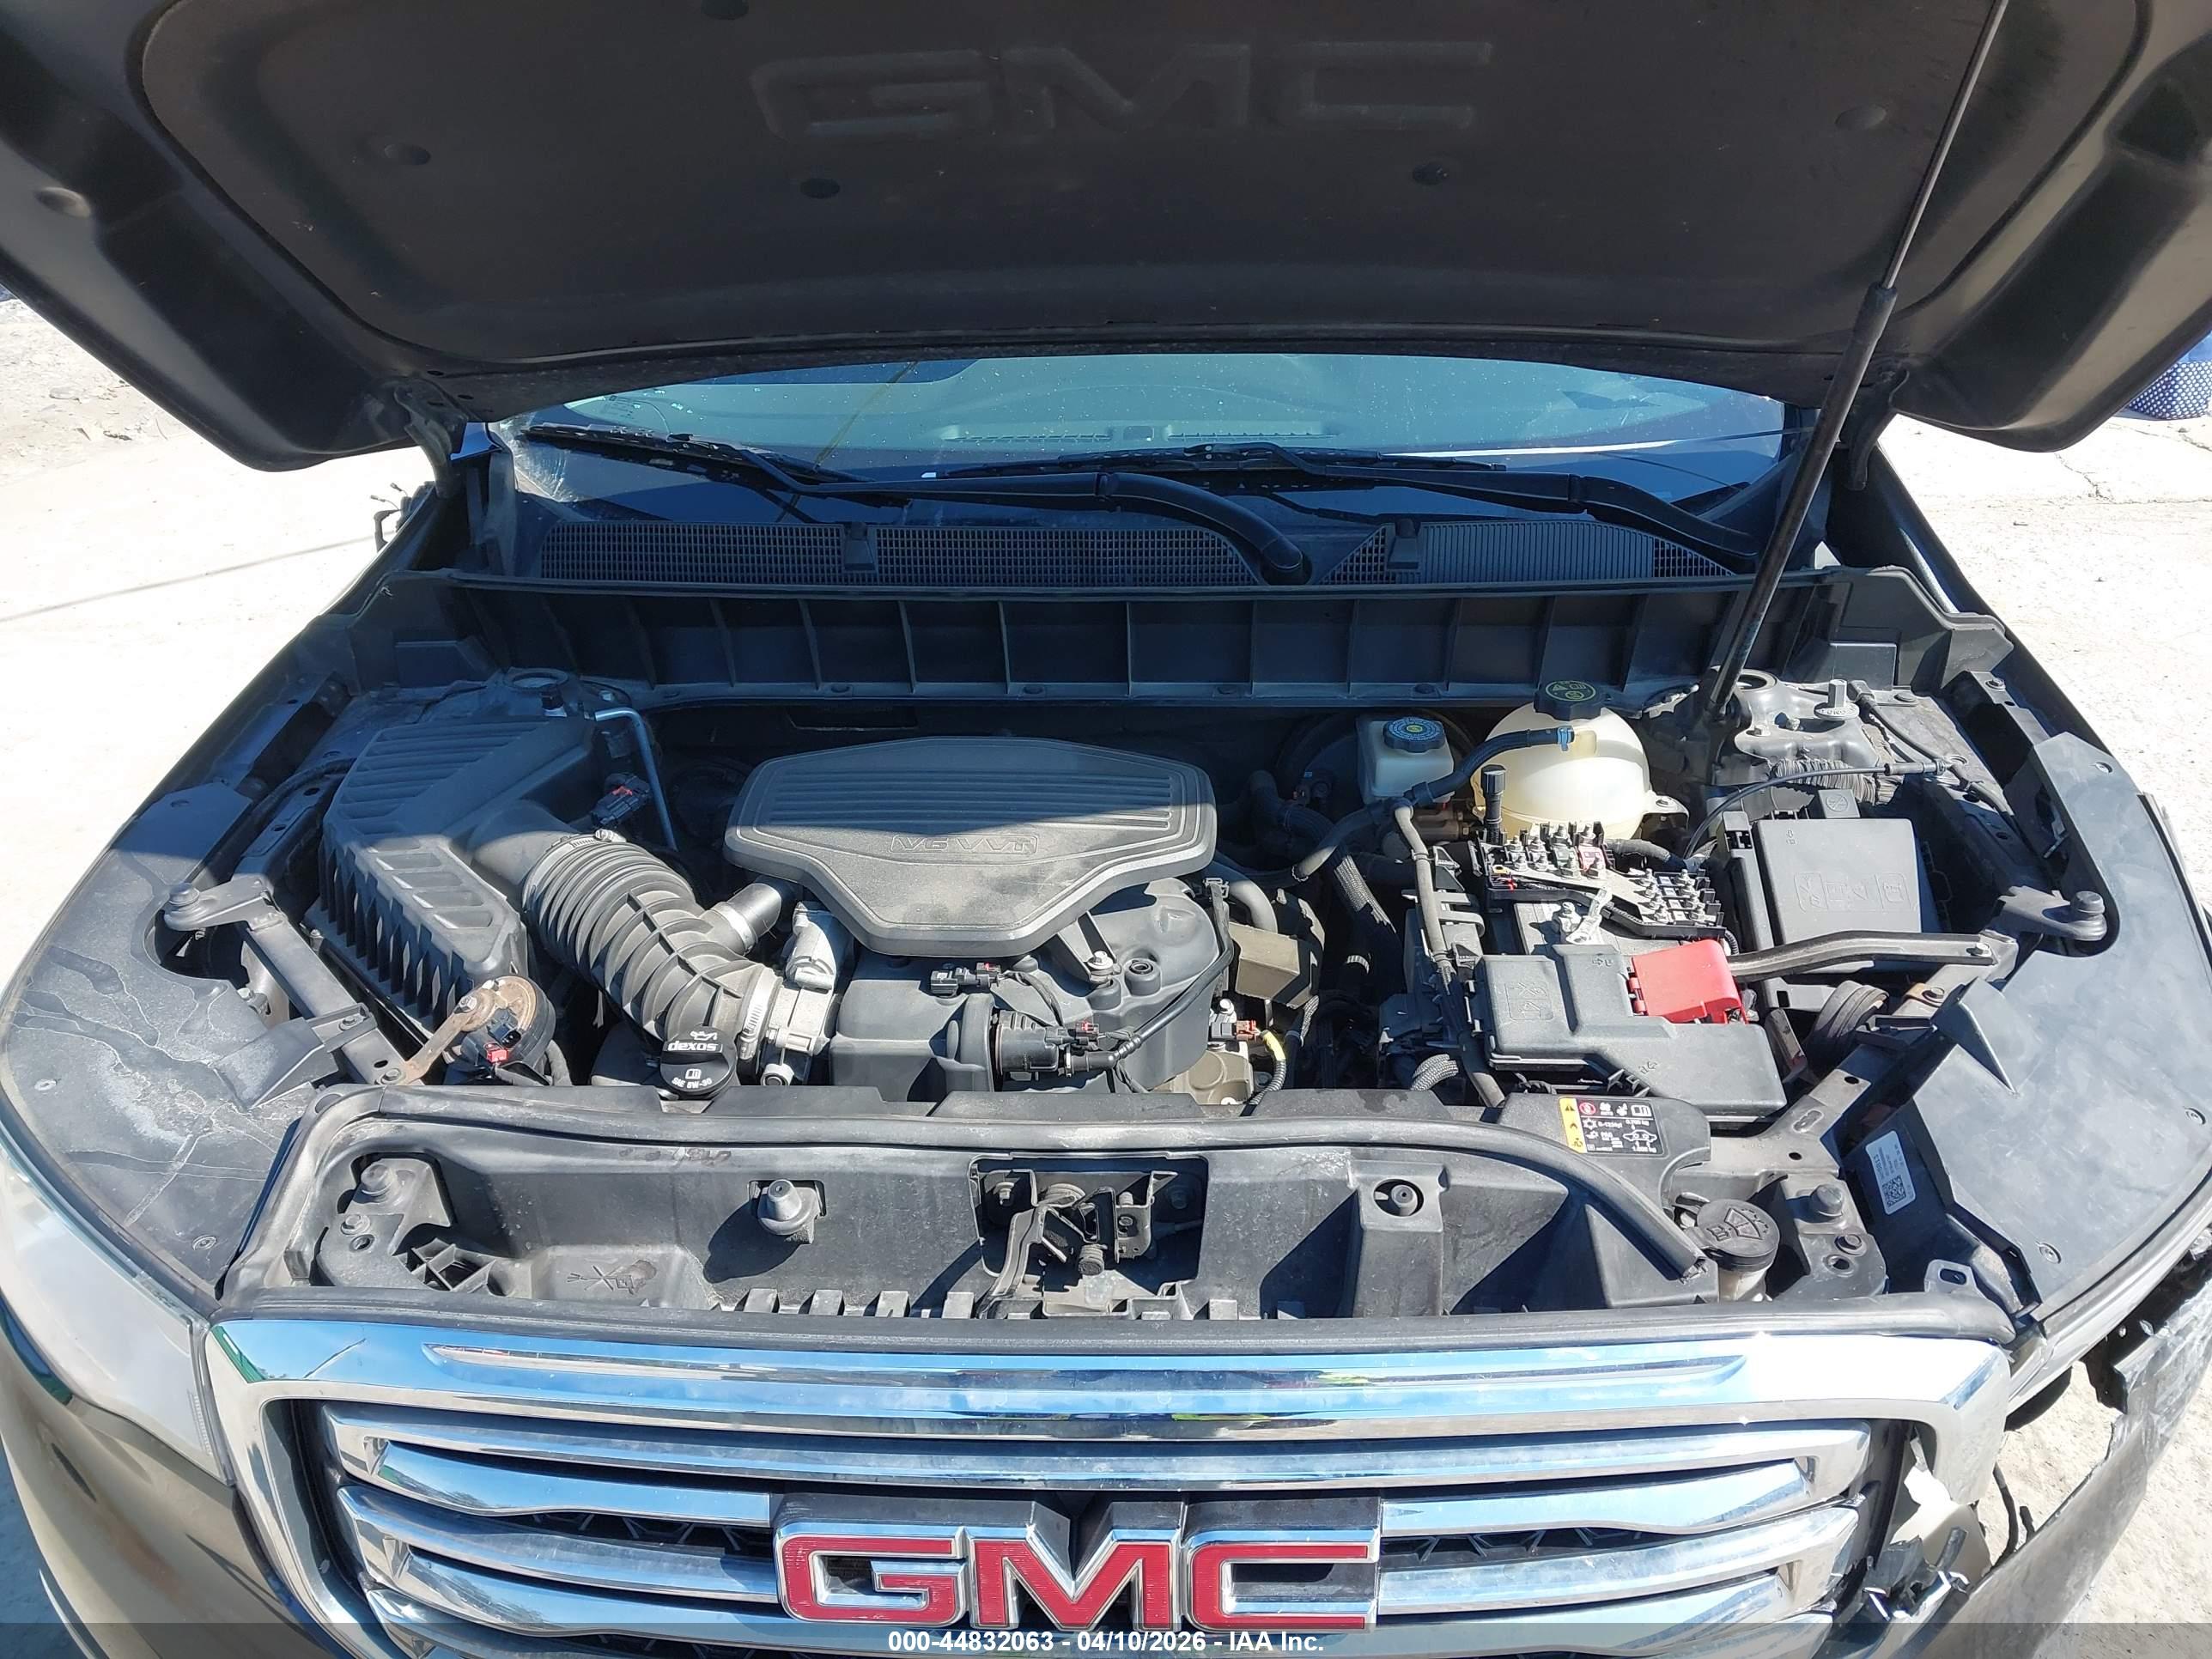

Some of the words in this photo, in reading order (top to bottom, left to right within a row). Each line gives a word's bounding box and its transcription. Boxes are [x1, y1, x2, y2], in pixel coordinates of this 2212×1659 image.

[749, 40, 1495, 143] GMC
[897, 837, 948, 851] V6
[955, 837, 1032, 852] VVT
[667, 1040, 720, 1052] dexos
[776, 1523, 1380, 1632] GMC
